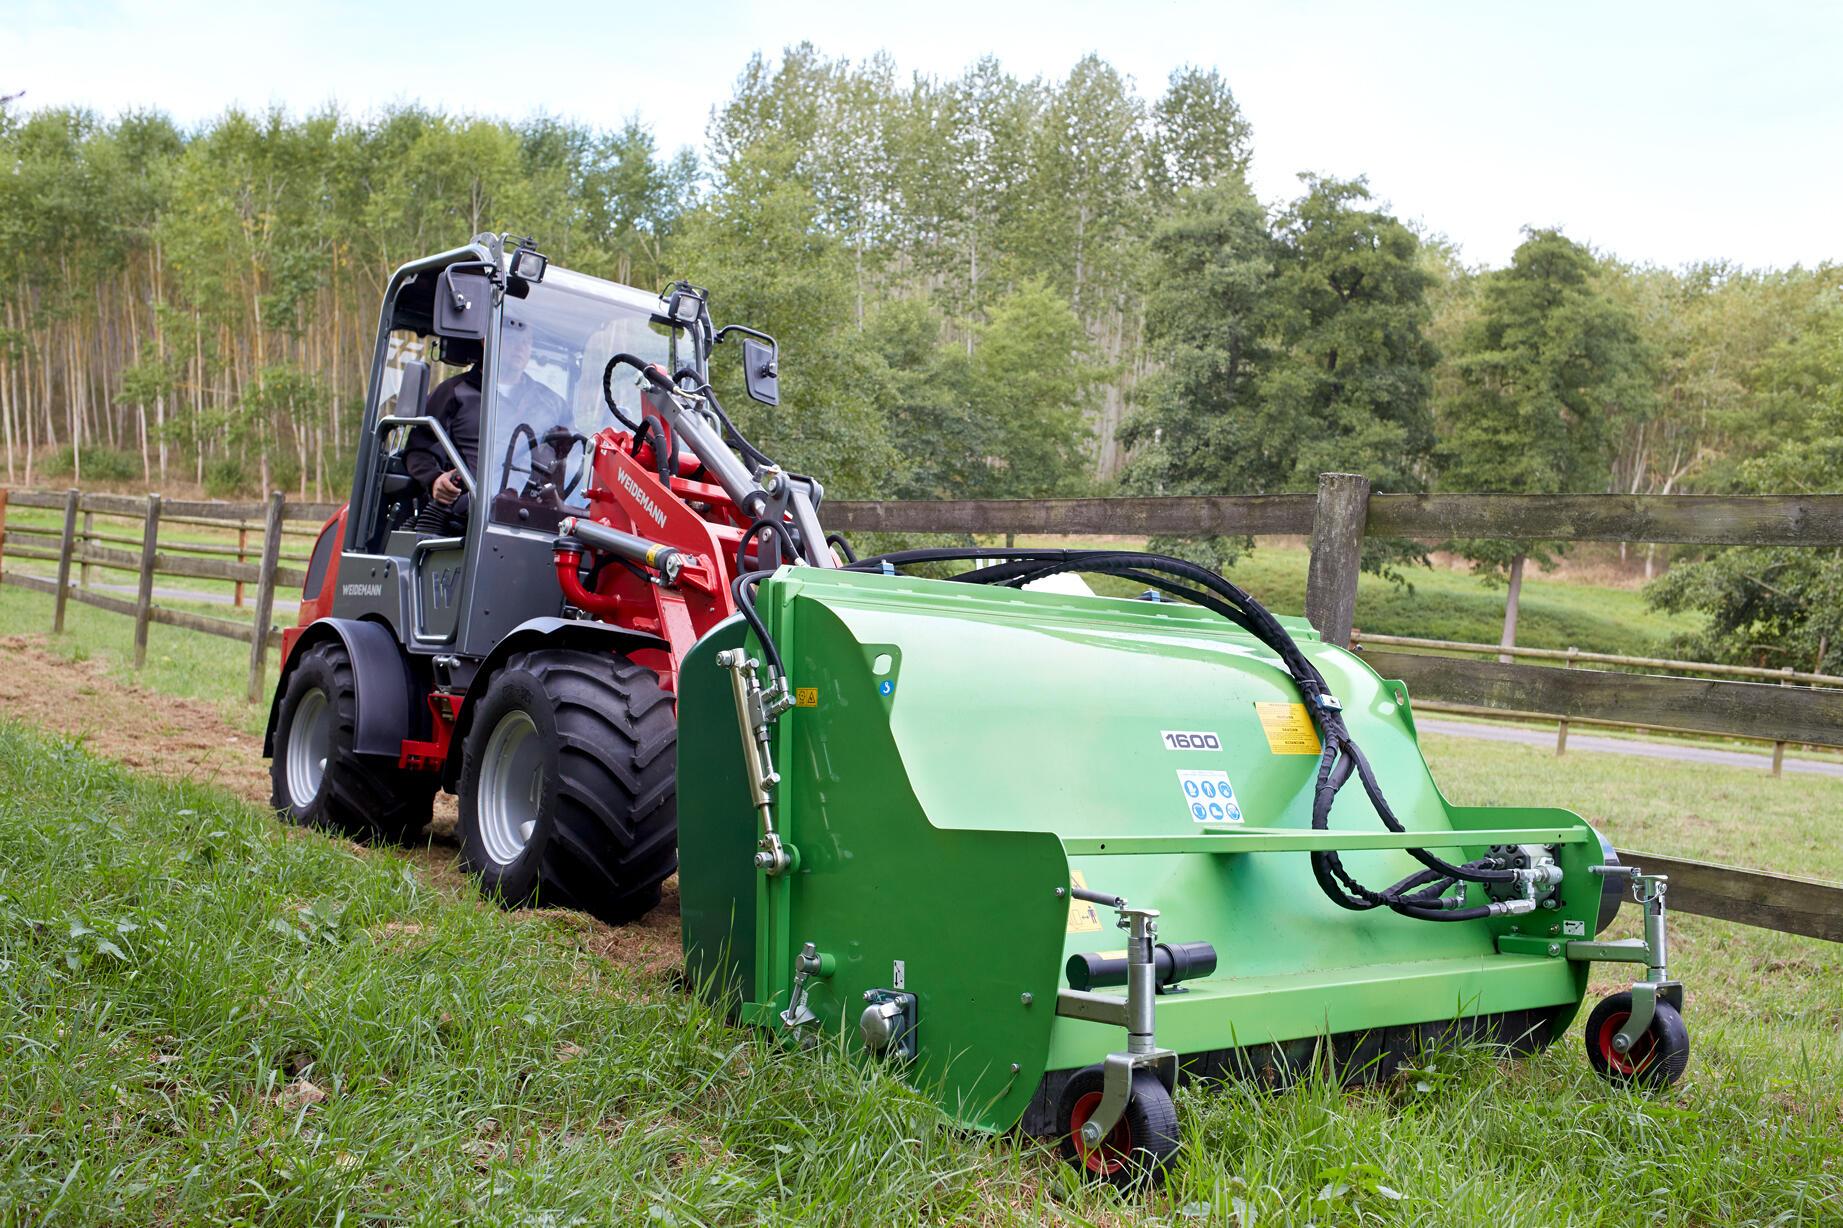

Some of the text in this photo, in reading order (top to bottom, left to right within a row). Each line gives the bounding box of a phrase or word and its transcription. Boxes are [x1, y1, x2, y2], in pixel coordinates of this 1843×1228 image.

[617, 466, 668, 529] WEIDEMANN
[342, 583, 382, 596] WEIDEMANN
[1165, 733, 1219, 749] 1600
